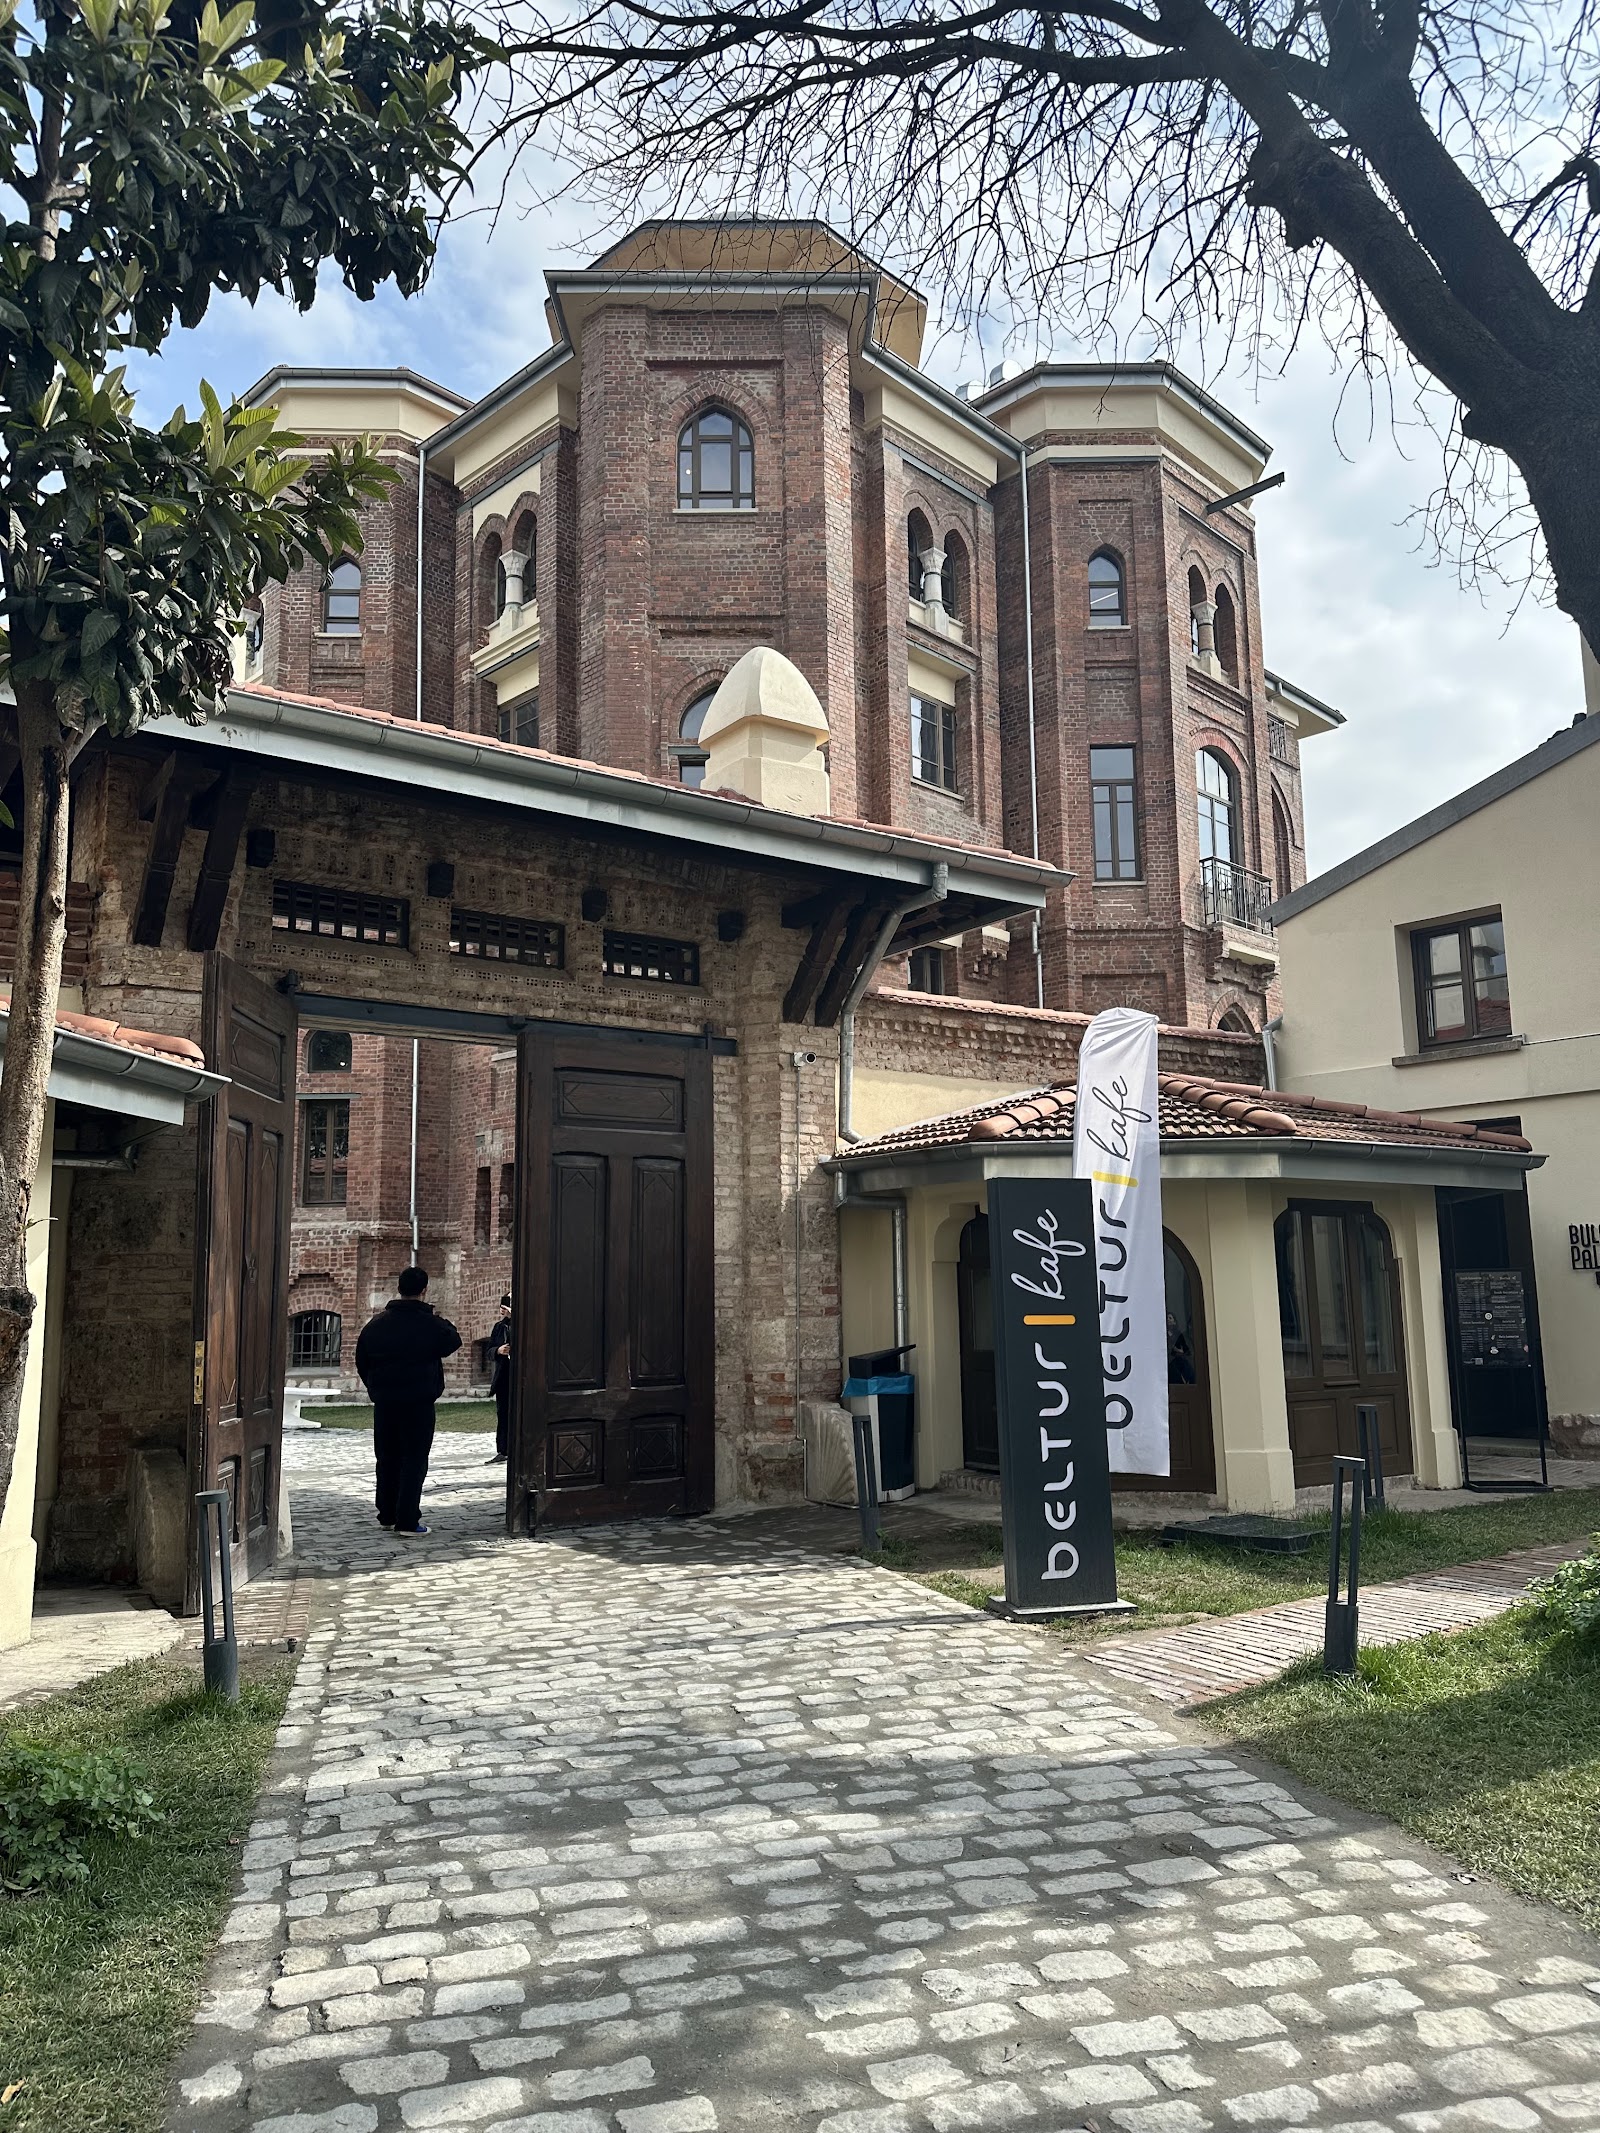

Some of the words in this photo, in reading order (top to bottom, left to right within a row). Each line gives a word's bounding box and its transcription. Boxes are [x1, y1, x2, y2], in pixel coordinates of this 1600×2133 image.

[1086, 1074, 1152, 1162] kafe
[1011, 1208, 1086, 1300] kafe
[1569, 1223, 1600, 1248] BUL
